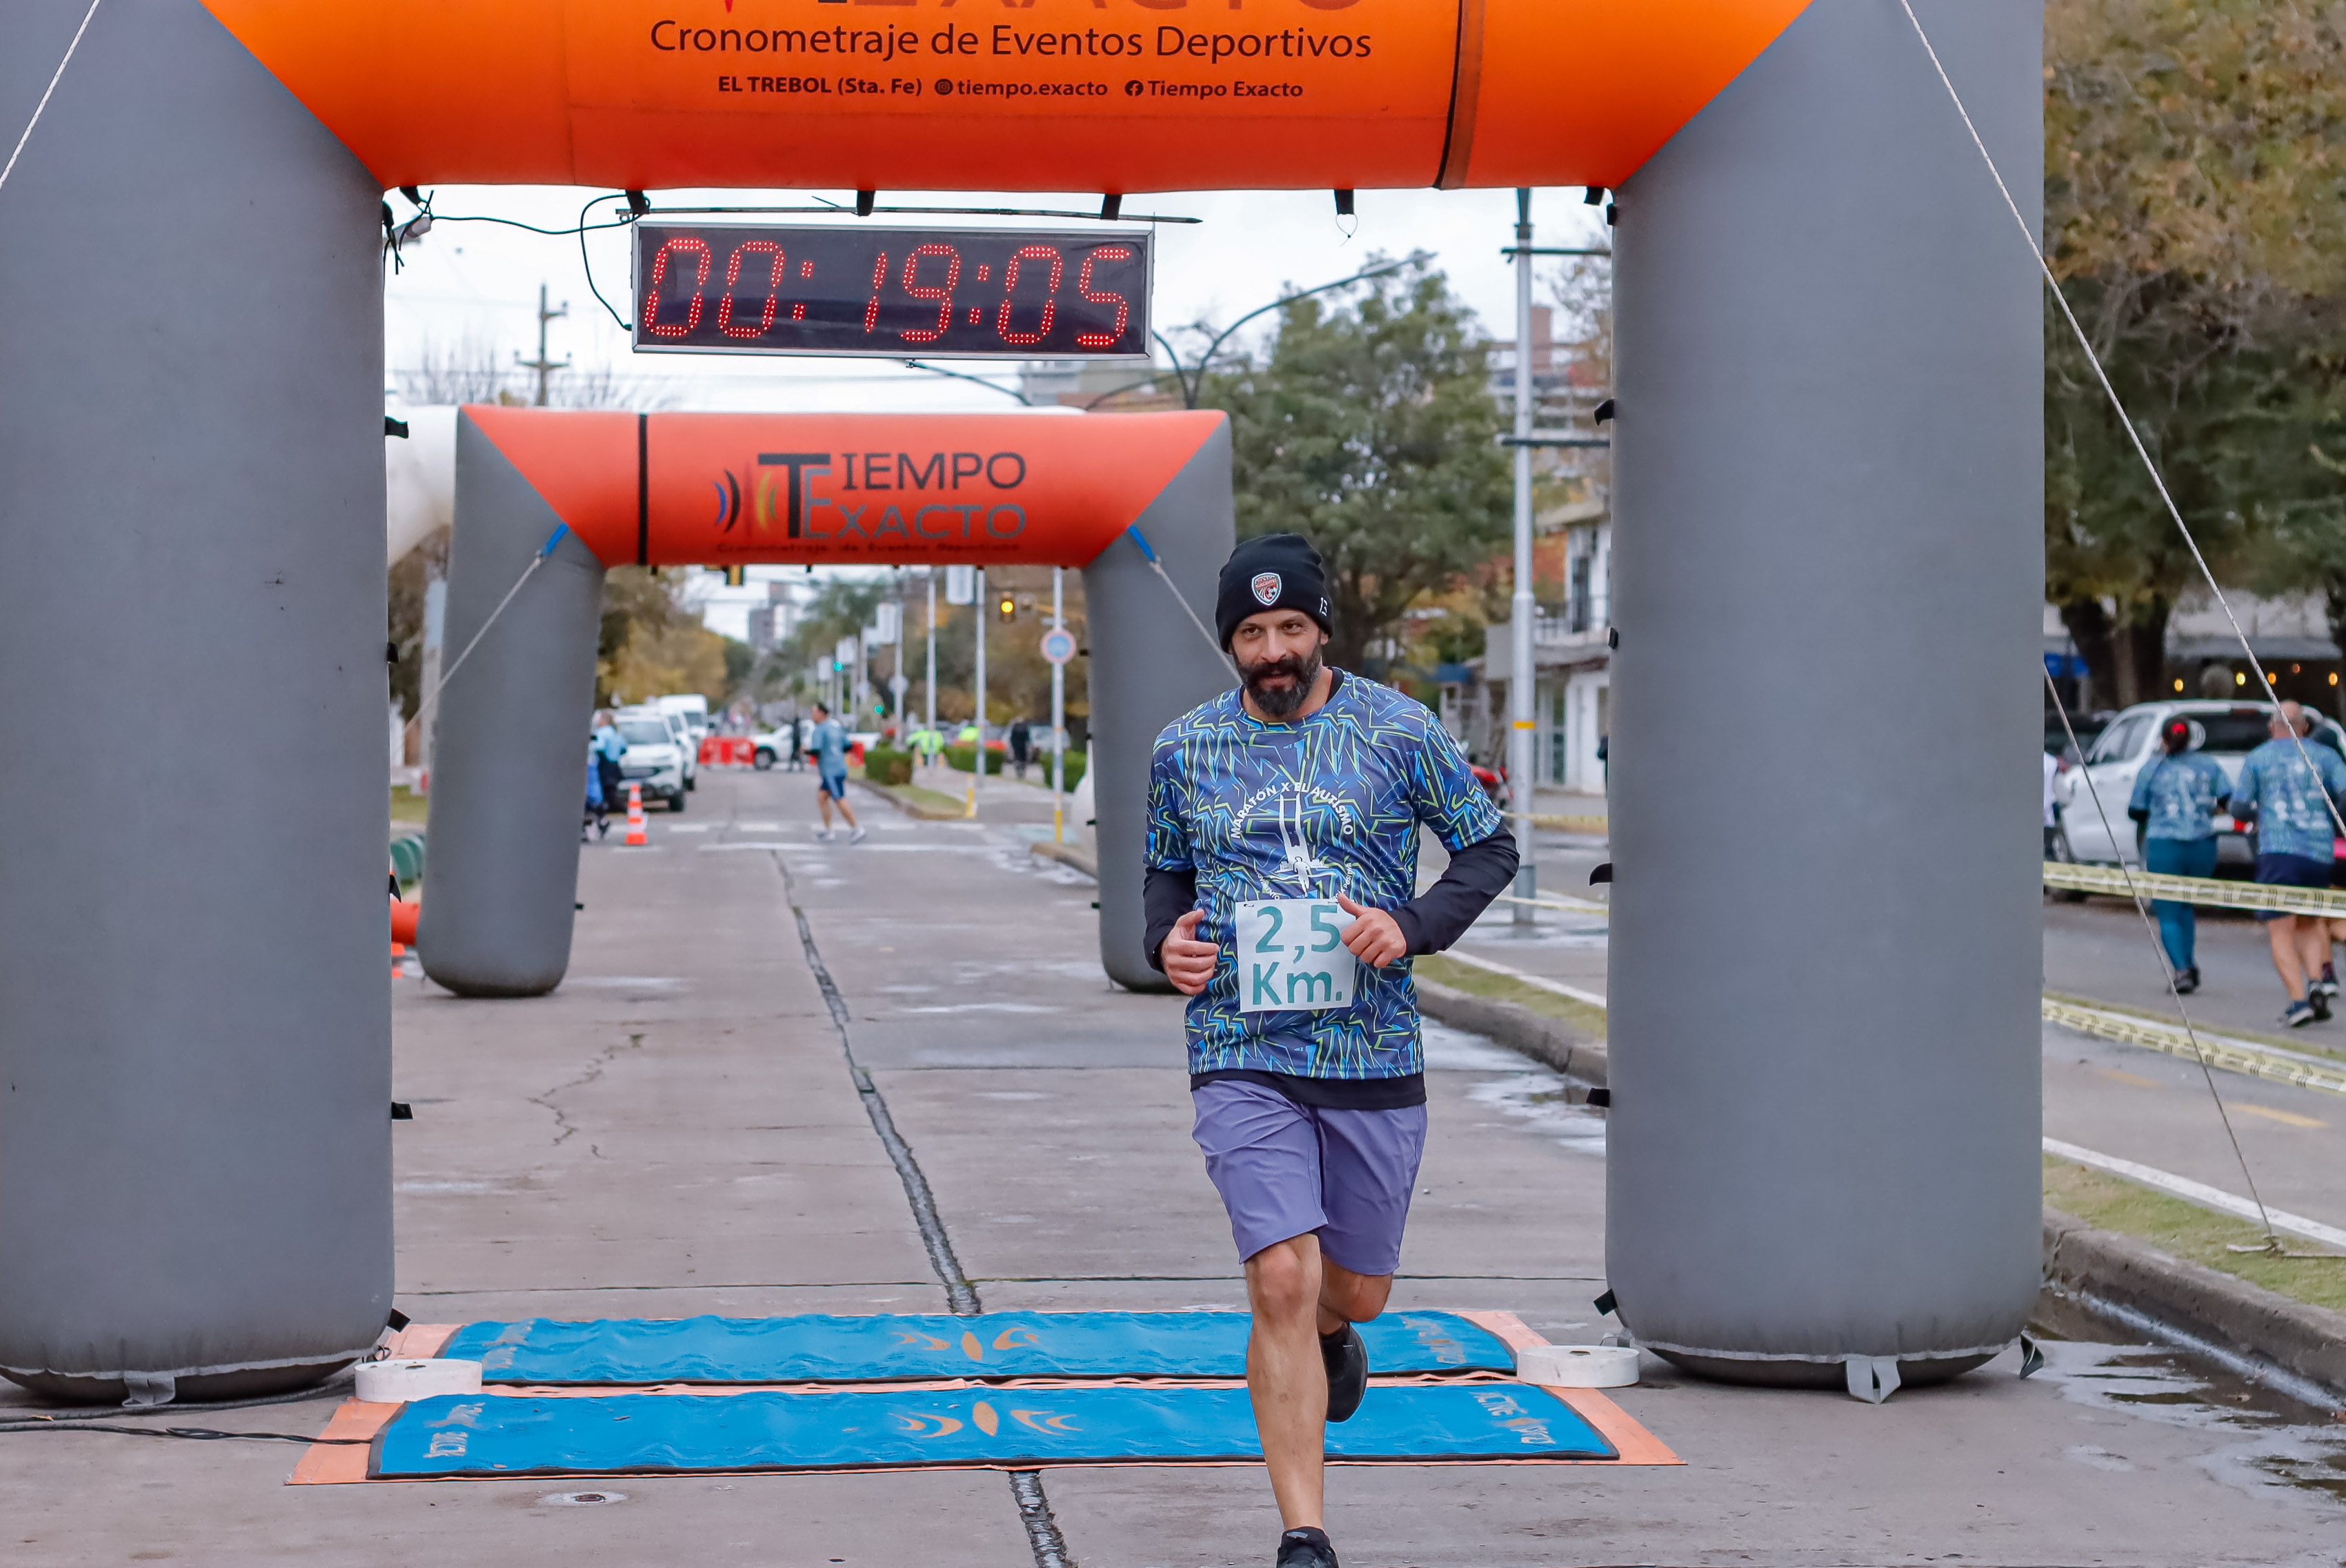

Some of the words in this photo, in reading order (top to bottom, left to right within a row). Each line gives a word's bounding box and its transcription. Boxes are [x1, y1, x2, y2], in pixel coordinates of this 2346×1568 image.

[650, 19, 919, 61] Cronometraje
[931, 23, 979, 54] de
[992, 24, 1143, 57] Eventos
[1156, 26, 1372, 64] Deportivos
[718, 77, 742, 92] EL
[746, 77, 832, 93] TREBOL
[837, 77, 886, 95] (Sta.
[891, 78, 922, 96] Fe)
[957, 78, 1108, 99] tiempo.exacto
[1148, 80, 1227, 99] Tiempo
[1233, 81, 1304, 97] Exacto
[1230, 784, 1277, 839] MARATÓN
[1280, 782, 1291, 792] X
[1294, 782, 1309, 793] EL
[1311, 785, 1353, 835] AUTISMO
[1255, 904, 1341, 964] 2,5
[1252, 962, 1342, 1006] Km.
